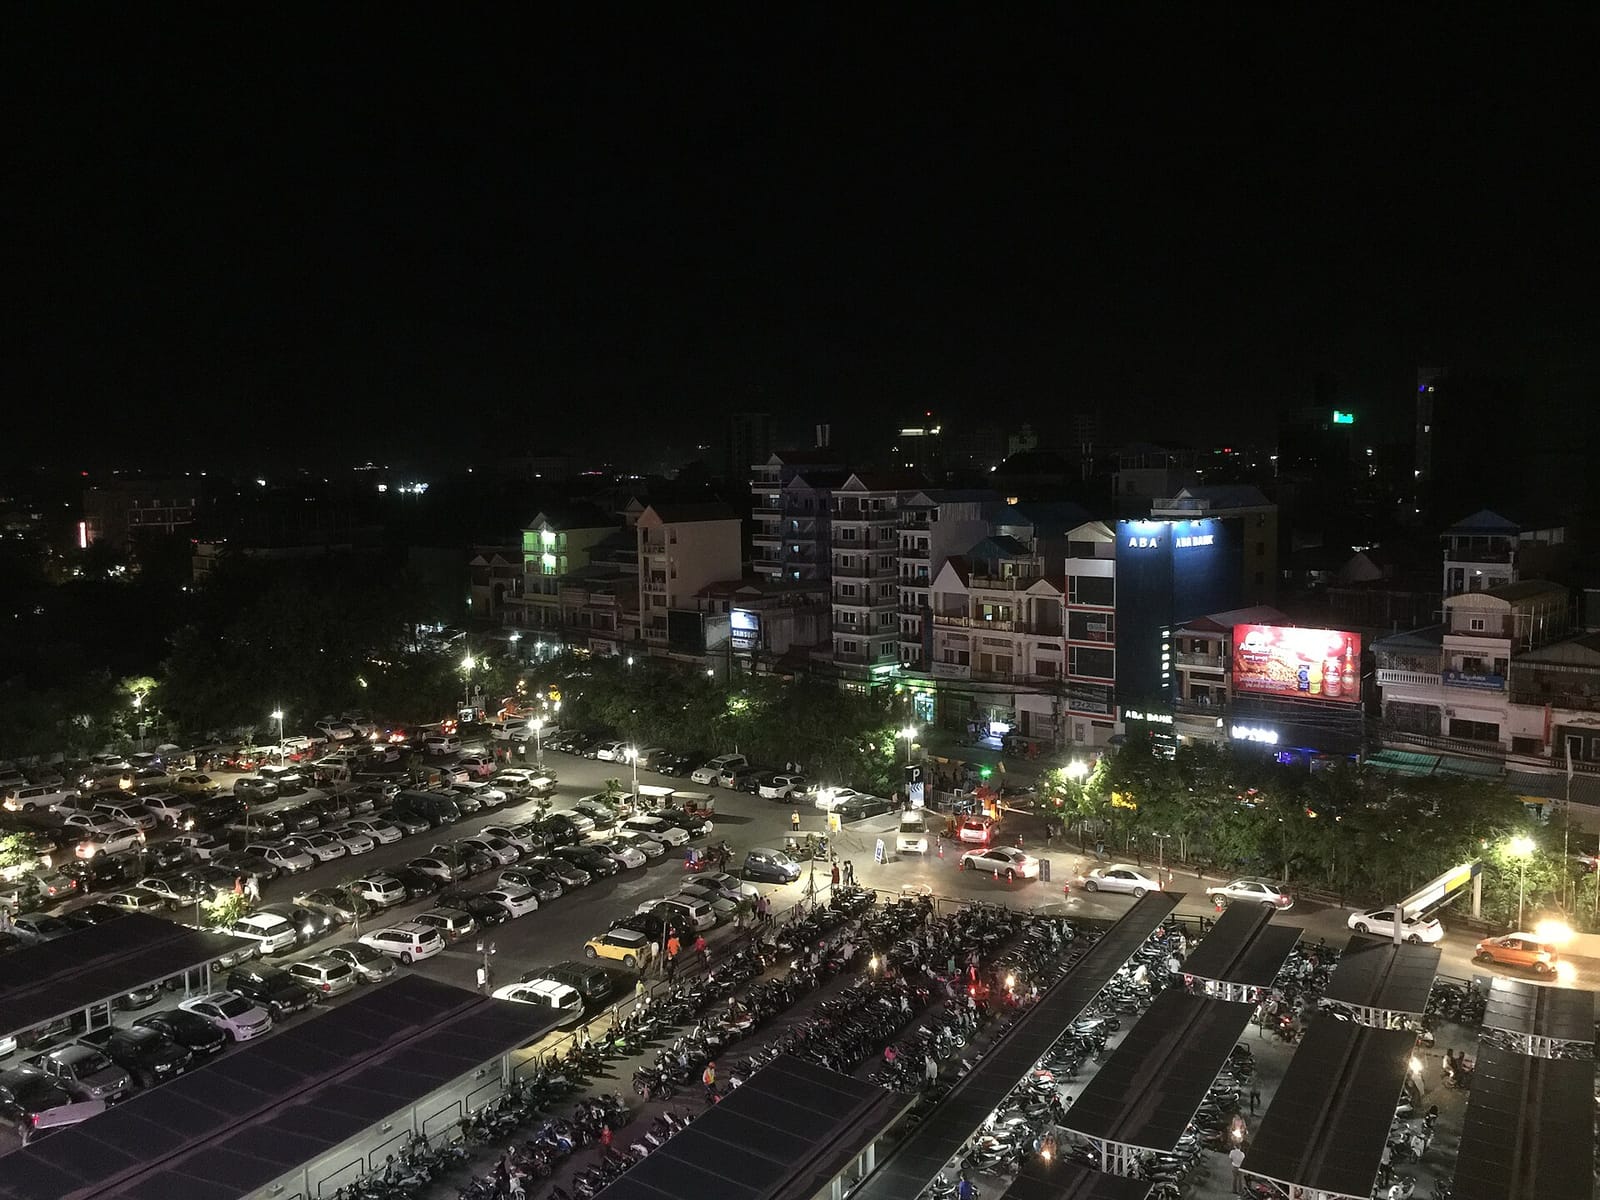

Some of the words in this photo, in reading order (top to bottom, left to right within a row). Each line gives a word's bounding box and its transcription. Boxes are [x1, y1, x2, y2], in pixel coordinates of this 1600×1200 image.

[1128, 537, 1158, 549] ABA
[1192, 534, 1214, 547] BANK
[1146, 713, 1173, 724] BANK
[912, 768, 921, 782] P
